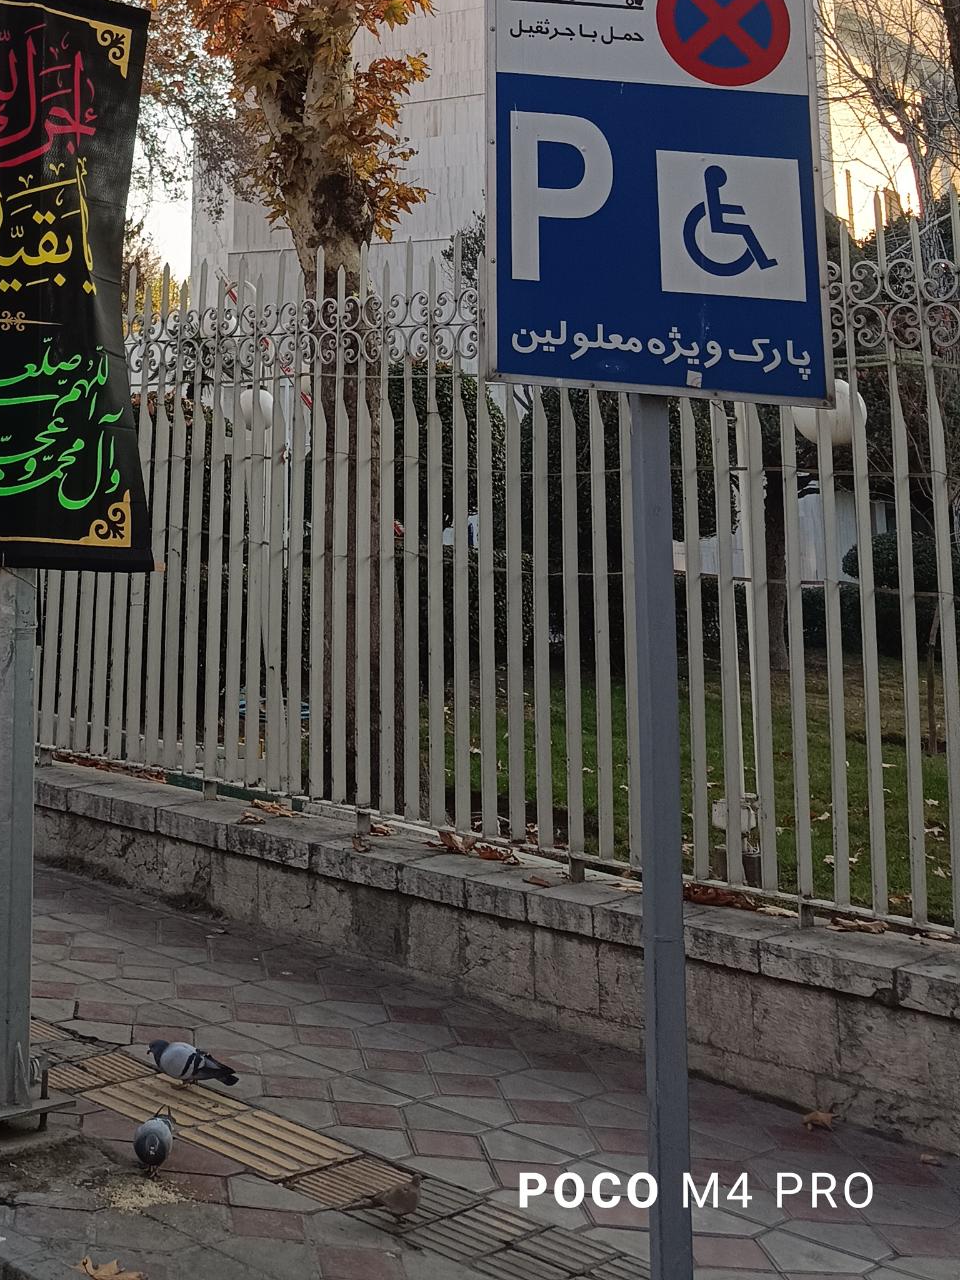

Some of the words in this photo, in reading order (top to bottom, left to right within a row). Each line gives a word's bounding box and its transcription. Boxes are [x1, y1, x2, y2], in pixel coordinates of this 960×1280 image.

[579, 23, 598, 43] با
[601, 26, 645, 45] حمل
[510, 109, 614, 282] P
[511, 320, 643, 361] معلولین
[647, 326, 723, 369] ویژه
[728, 337, 811, 382] پارک
